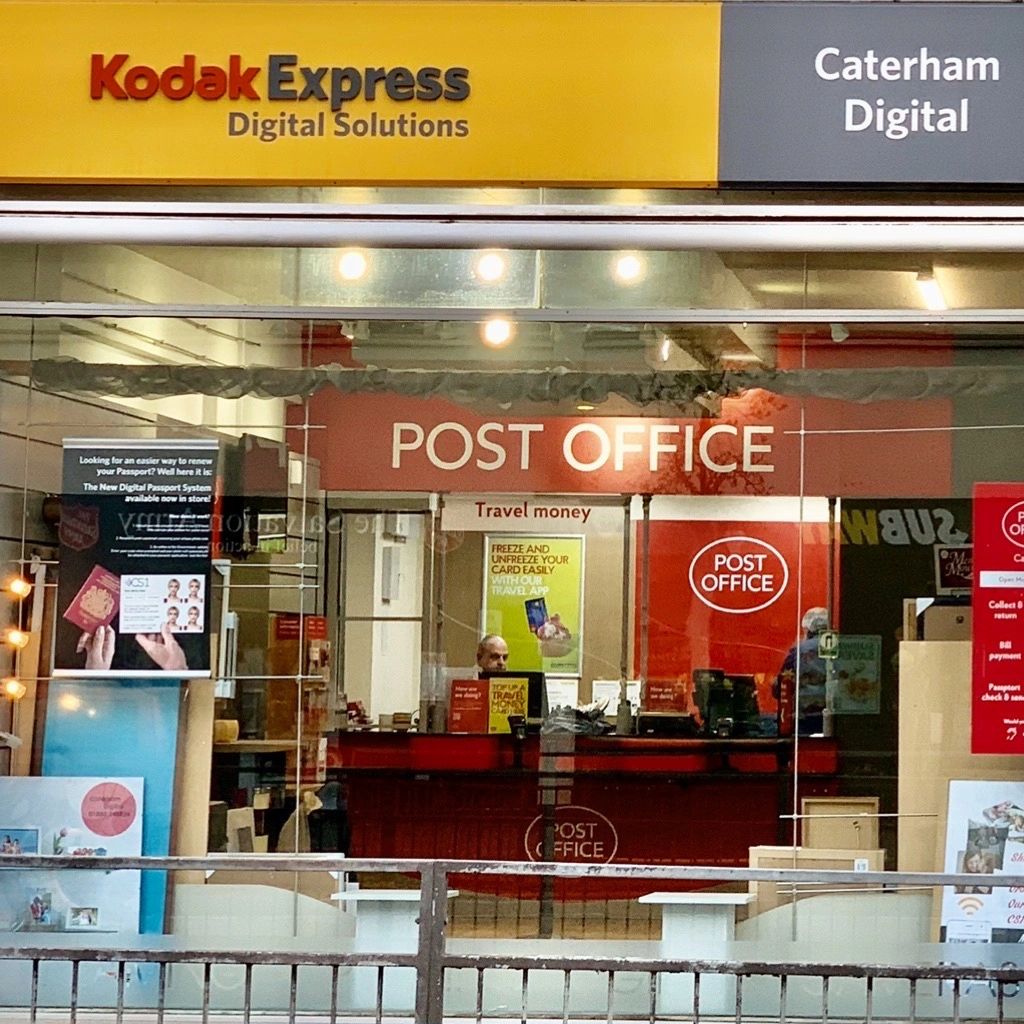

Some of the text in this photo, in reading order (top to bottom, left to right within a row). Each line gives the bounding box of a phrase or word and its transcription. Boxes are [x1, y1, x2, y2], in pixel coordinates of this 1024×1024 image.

[815, 47, 999, 80] Caterham
[845, 99, 968, 139] Digital
[227, 110, 470, 144] Digital Solutions
[391, 421, 775, 473] POST OFFICE
[79, 456, 111, 466] Looking
[111, 456, 123, 465] for
[124, 457, 135, 465] an
[136, 456, 160, 465] easier
[161, 458, 177, 466] way
[178, 457, 187, 465] to
[96, 468, 115, 477] your
[116, 467, 156, 477] Passport?
[157, 467, 175, 476] Well
[176, 467, 194, 476] here
[195, 467, 202, 476] it
[83, 482, 212, 493] The New Digital Passport System
[124, 494, 211, 503] available now in store!
[475, 501, 592, 523] Travel money
[491, 544, 550, 554] FREEZE AND
[491, 555, 569, 564] UNFREEZE YOUR
[714, 553, 768, 573] POST
[491, 565, 555, 575] CARD EASILY
[492, 575, 543, 585] WITH OUR
[701, 574, 773, 593] OFFICE
[492, 586, 549, 595] TRAVEL APP
[988, 600, 1016, 609] Collect
[999, 640, 1012, 649] Bill
[988, 653, 1022, 662] payment
[981, 693, 1003, 701] check
[1008, 899, 1024, 910] Our
